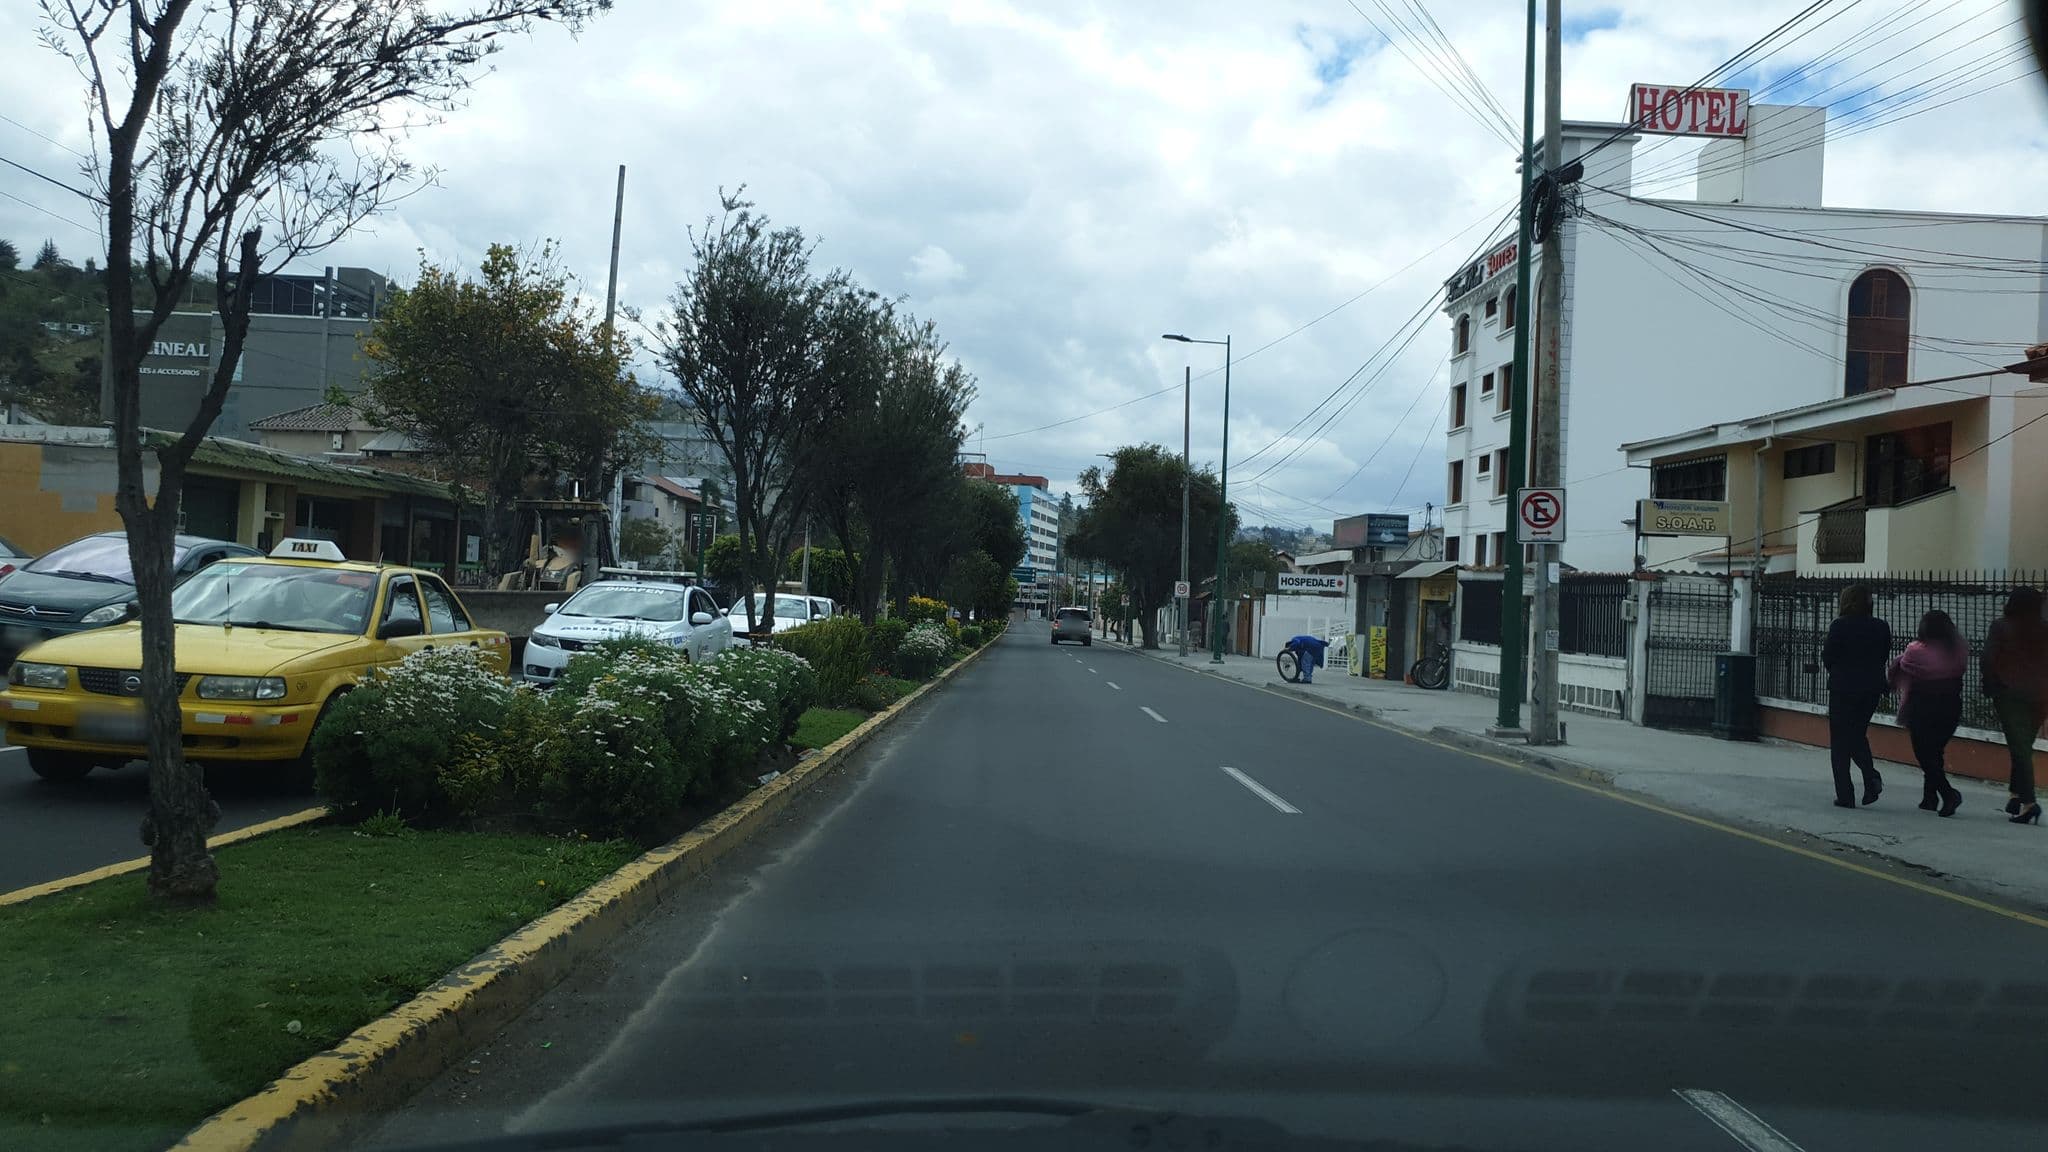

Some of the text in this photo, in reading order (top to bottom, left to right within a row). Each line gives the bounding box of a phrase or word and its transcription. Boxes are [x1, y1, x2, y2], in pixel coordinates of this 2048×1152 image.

[1637, 87, 1746, 134] HOTEL
[147, 341, 209, 357] INEAL
[157, 368, 201, 376] ACCESORIOS
[1656, 516, 1716, 531] S.O.A.T.
[291, 542, 318, 552] TAXI
[1281, 577, 1336, 588] HOSPEDAJE
